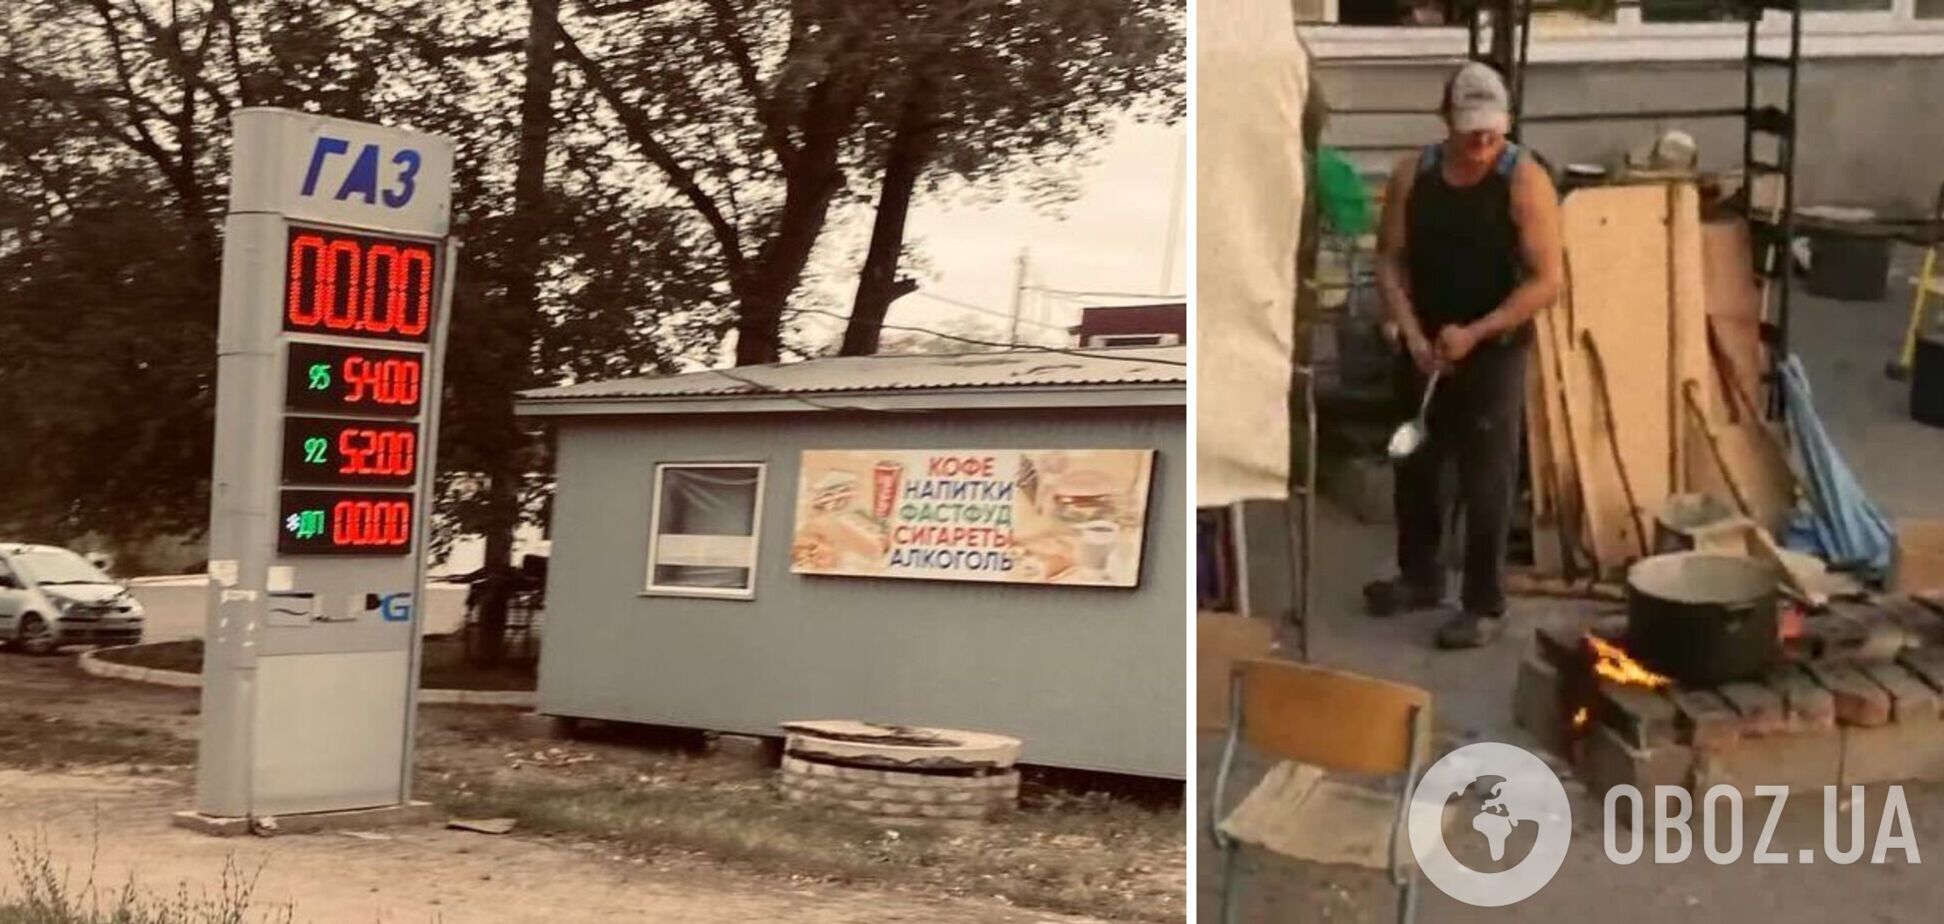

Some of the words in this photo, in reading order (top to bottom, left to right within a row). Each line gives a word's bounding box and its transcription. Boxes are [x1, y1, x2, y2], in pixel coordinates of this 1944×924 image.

[300, 137, 421, 208] ГАЗ
[289, 235, 432, 335] 00.00
[308, 364, 331, 390] 95
[304, 437, 327, 463] 92
[928, 457, 995, 476] КОФЕ
[904, 480, 1014, 500] НАПИТКИ
[900, 503, 1012, 526] ФАСТФУД
[894, 525, 1014, 547] СИГАРЕТЫ
[889, 548, 1014, 571] АЛКОГОЛЬ
